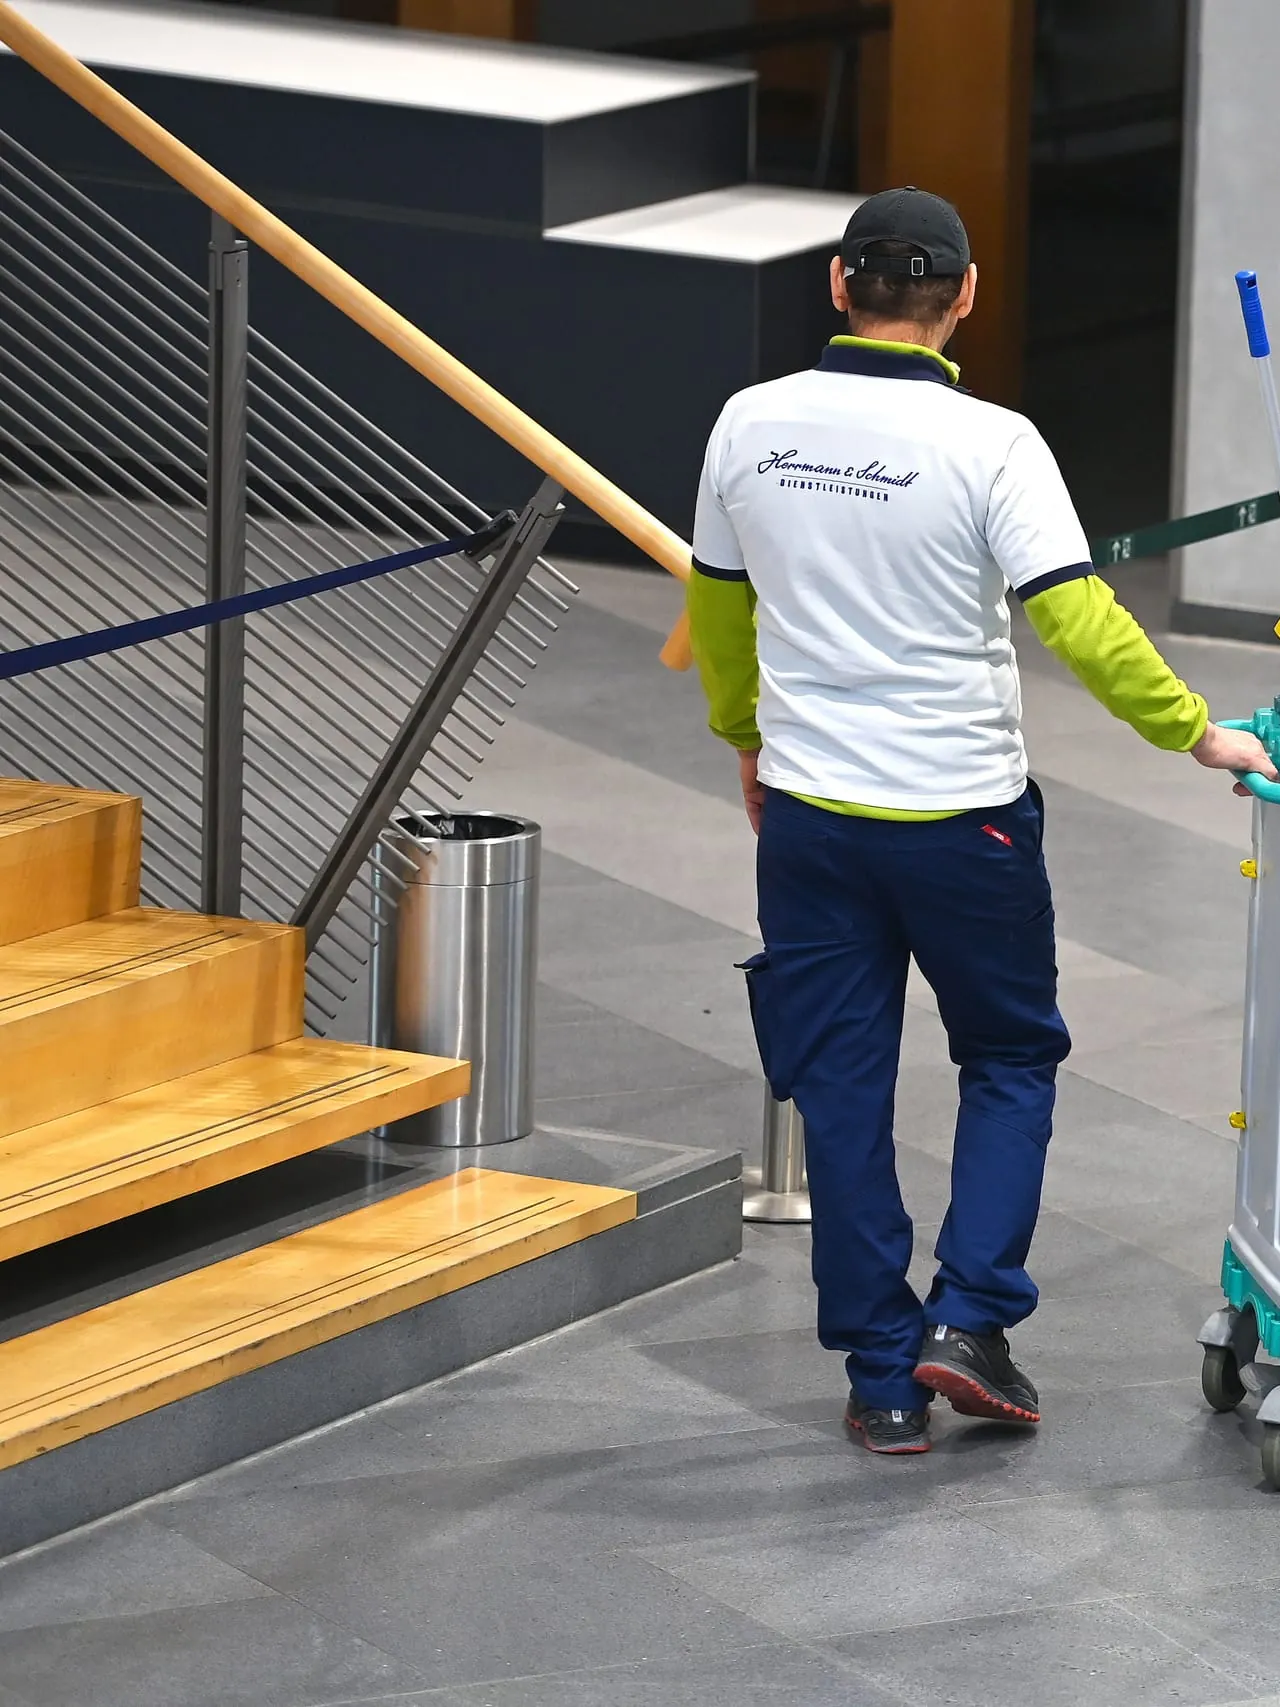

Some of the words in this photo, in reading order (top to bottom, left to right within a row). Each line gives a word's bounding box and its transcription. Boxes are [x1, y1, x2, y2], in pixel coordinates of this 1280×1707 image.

[757, 449, 841, 474] Herrmann
[844, 466, 854, 477] &
[856, 460, 919, 488] Schmidt
[779, 478, 889, 502] DIENSTLEISTUNGEN
